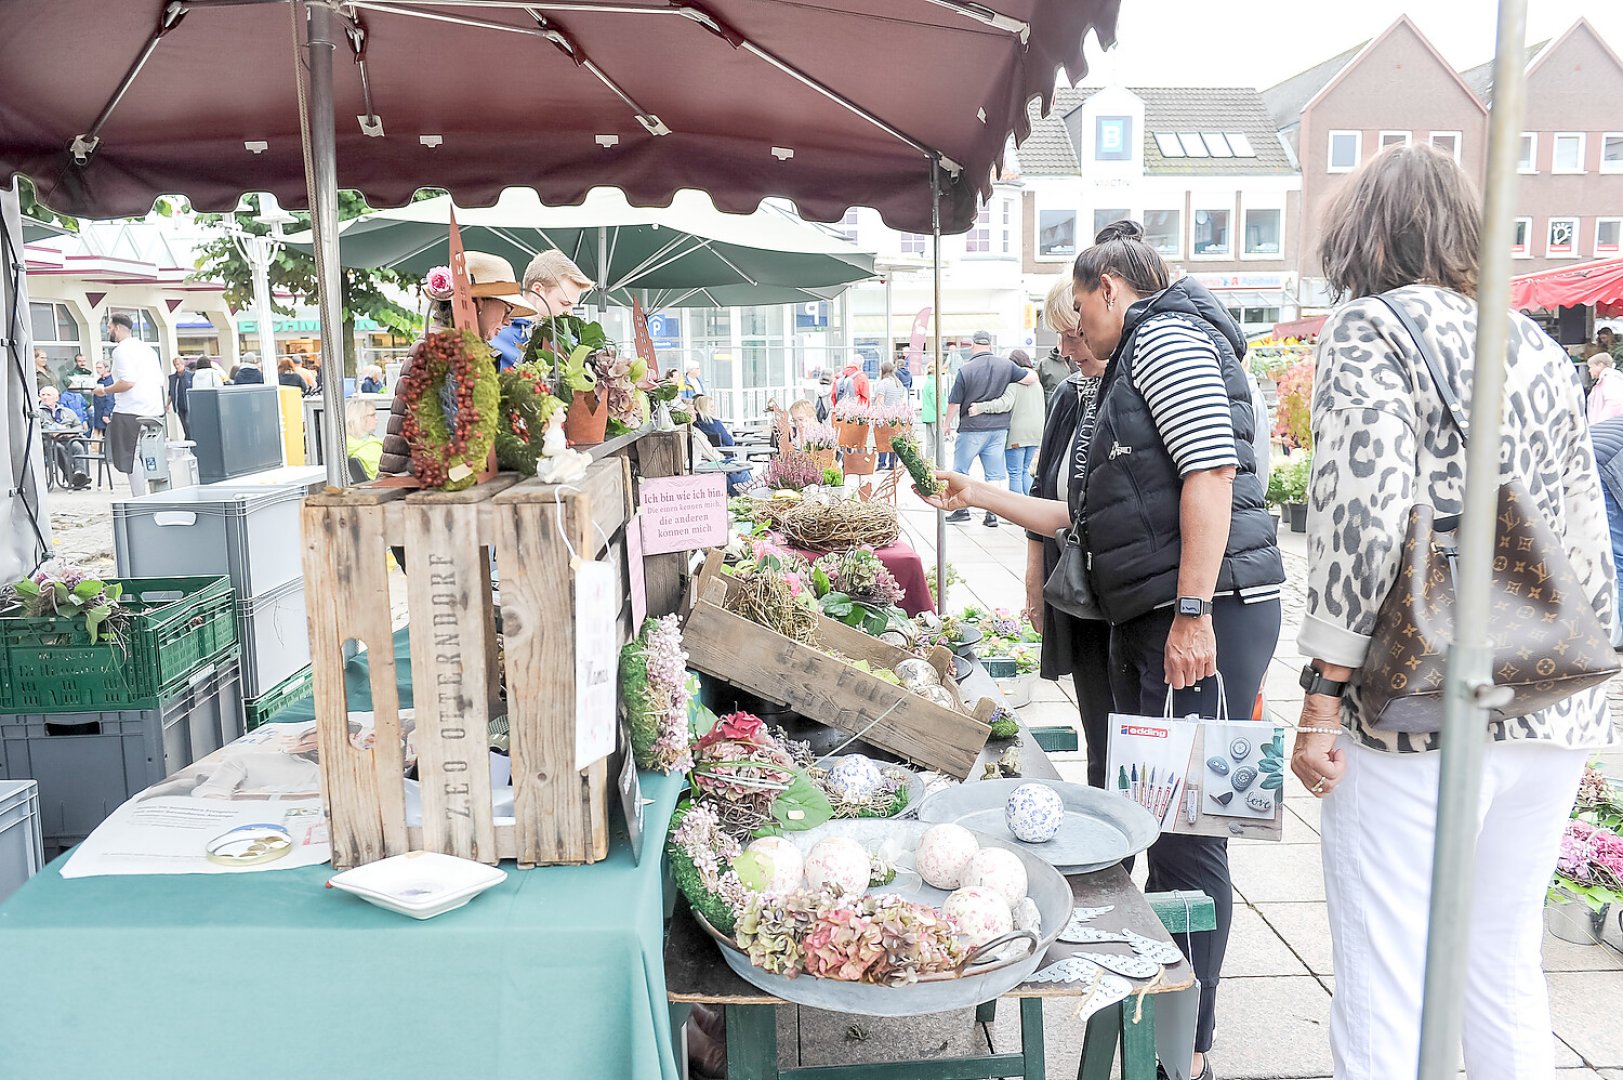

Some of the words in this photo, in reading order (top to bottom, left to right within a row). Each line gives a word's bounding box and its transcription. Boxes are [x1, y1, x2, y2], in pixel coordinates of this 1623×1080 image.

[1073, 402, 1097, 479] MONCLER
[644, 492, 658, 504] Ich
[660, 491, 674, 503] bin
[676, 489, 691, 501] wie
[692, 488, 706, 500] ich
[707, 487, 724, 498] bin.
[647, 506, 659, 515] Die
[660, 505, 678, 513] einen
[680, 503, 703, 511] kennen
[659, 516, 673, 526] die
[674, 513, 709, 524] anderen
[691, 524, 712, 534] mich
[428, 553, 466, 740] OTTERNDORF
[1129, 726, 1167, 738] edding
[1244, 790, 1272, 809] love
